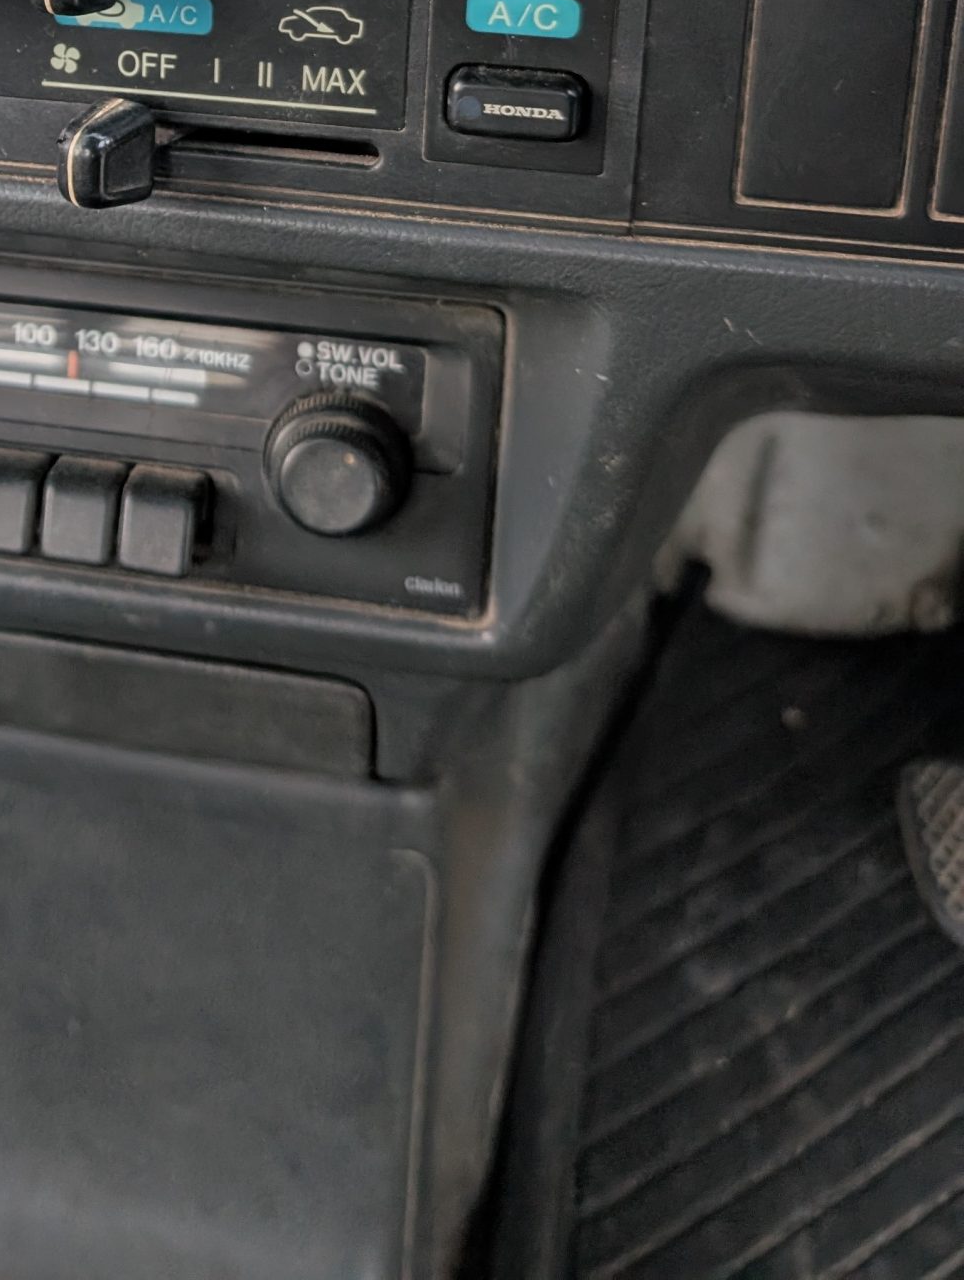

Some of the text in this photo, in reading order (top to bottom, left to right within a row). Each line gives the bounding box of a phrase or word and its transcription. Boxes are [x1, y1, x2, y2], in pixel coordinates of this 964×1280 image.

[148, 2, 198, 26] A/C
[487, 0, 558, 31] A/C
[117, 49, 178, 80] OFF
[301, 64, 366, 96] MAX
[482, 102, 566, 121] HONDA
[12, 321, 57, 347] 100
[74, 328, 119, 354] 130
[135, 334, 179, 361] 160
[316, 361, 380, 388] TONE
